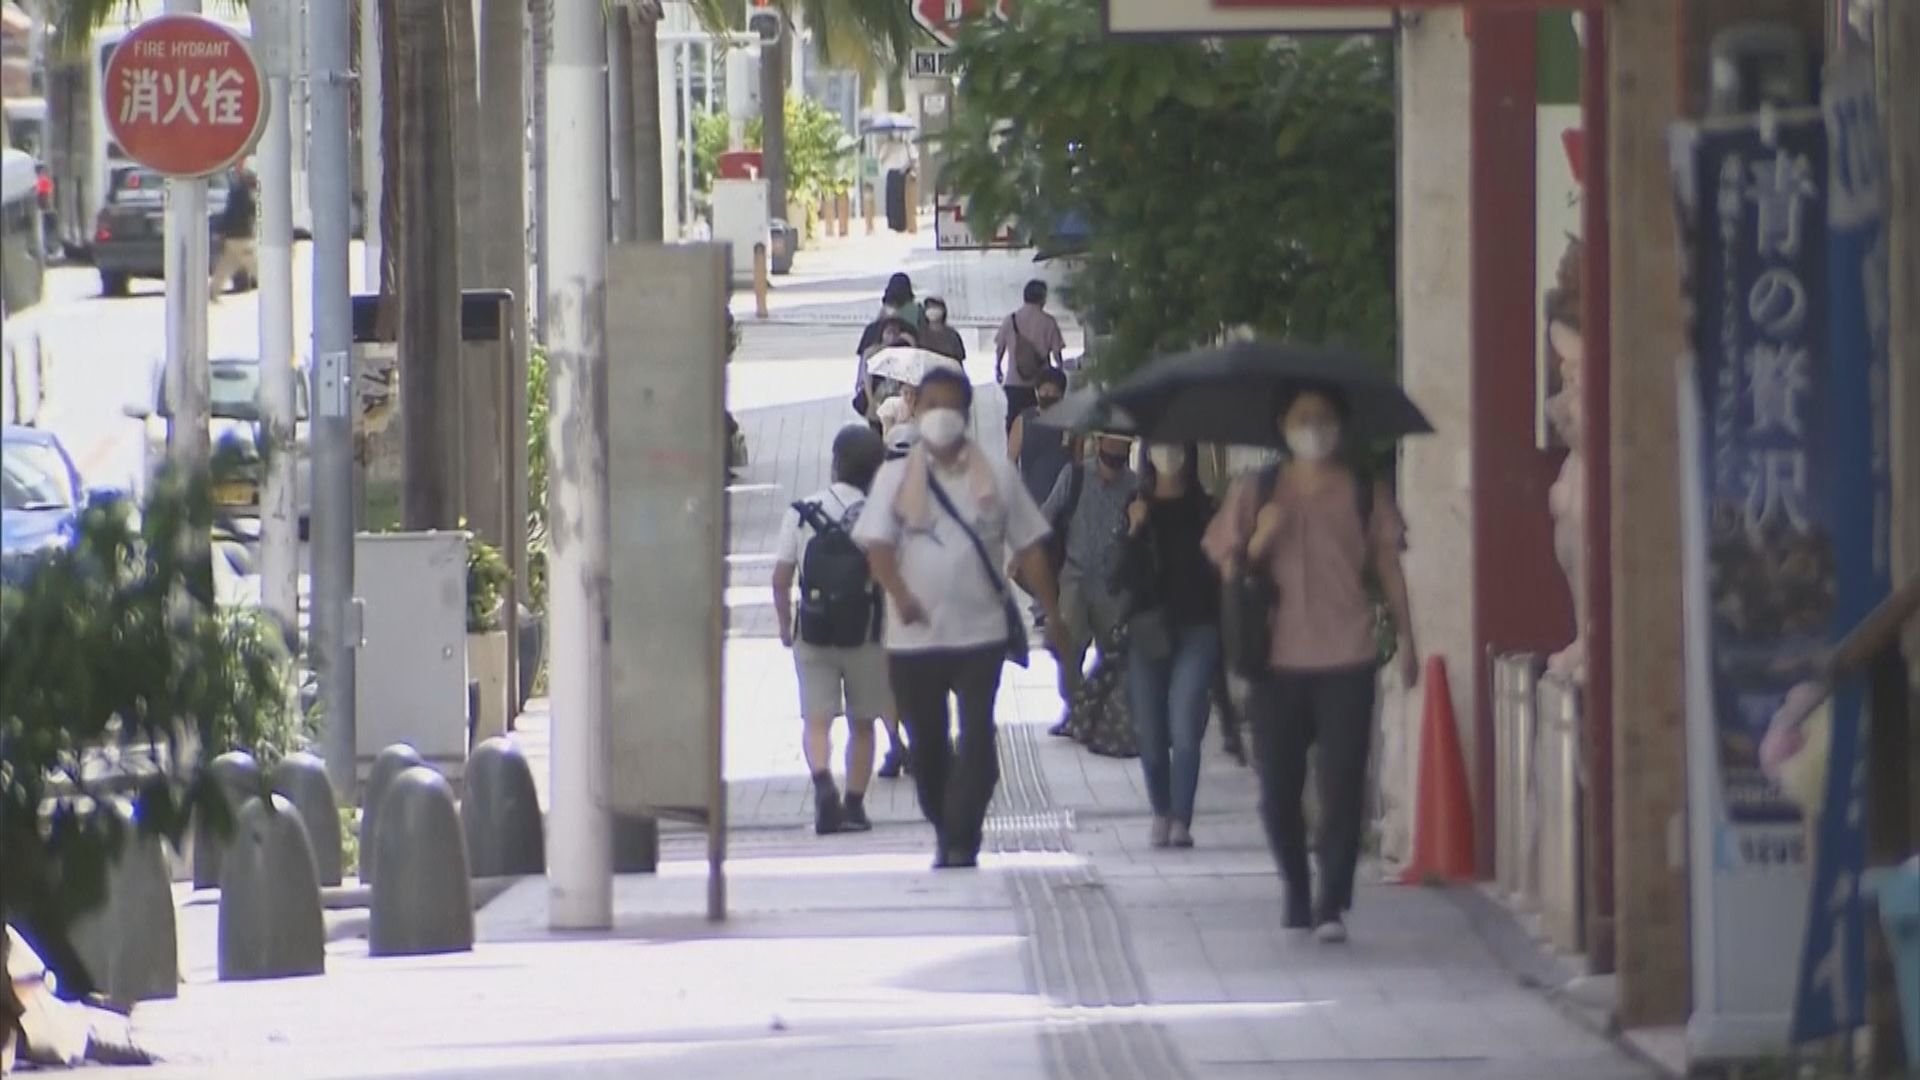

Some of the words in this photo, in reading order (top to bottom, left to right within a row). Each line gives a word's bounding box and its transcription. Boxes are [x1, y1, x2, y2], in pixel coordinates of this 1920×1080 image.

[134, 40, 165, 57] FIRE
[171, 40, 230, 57] HYDRANT
[119, 67, 245, 125] 消火栓
[1744, 148, 1817, 538] 青の贅沢
